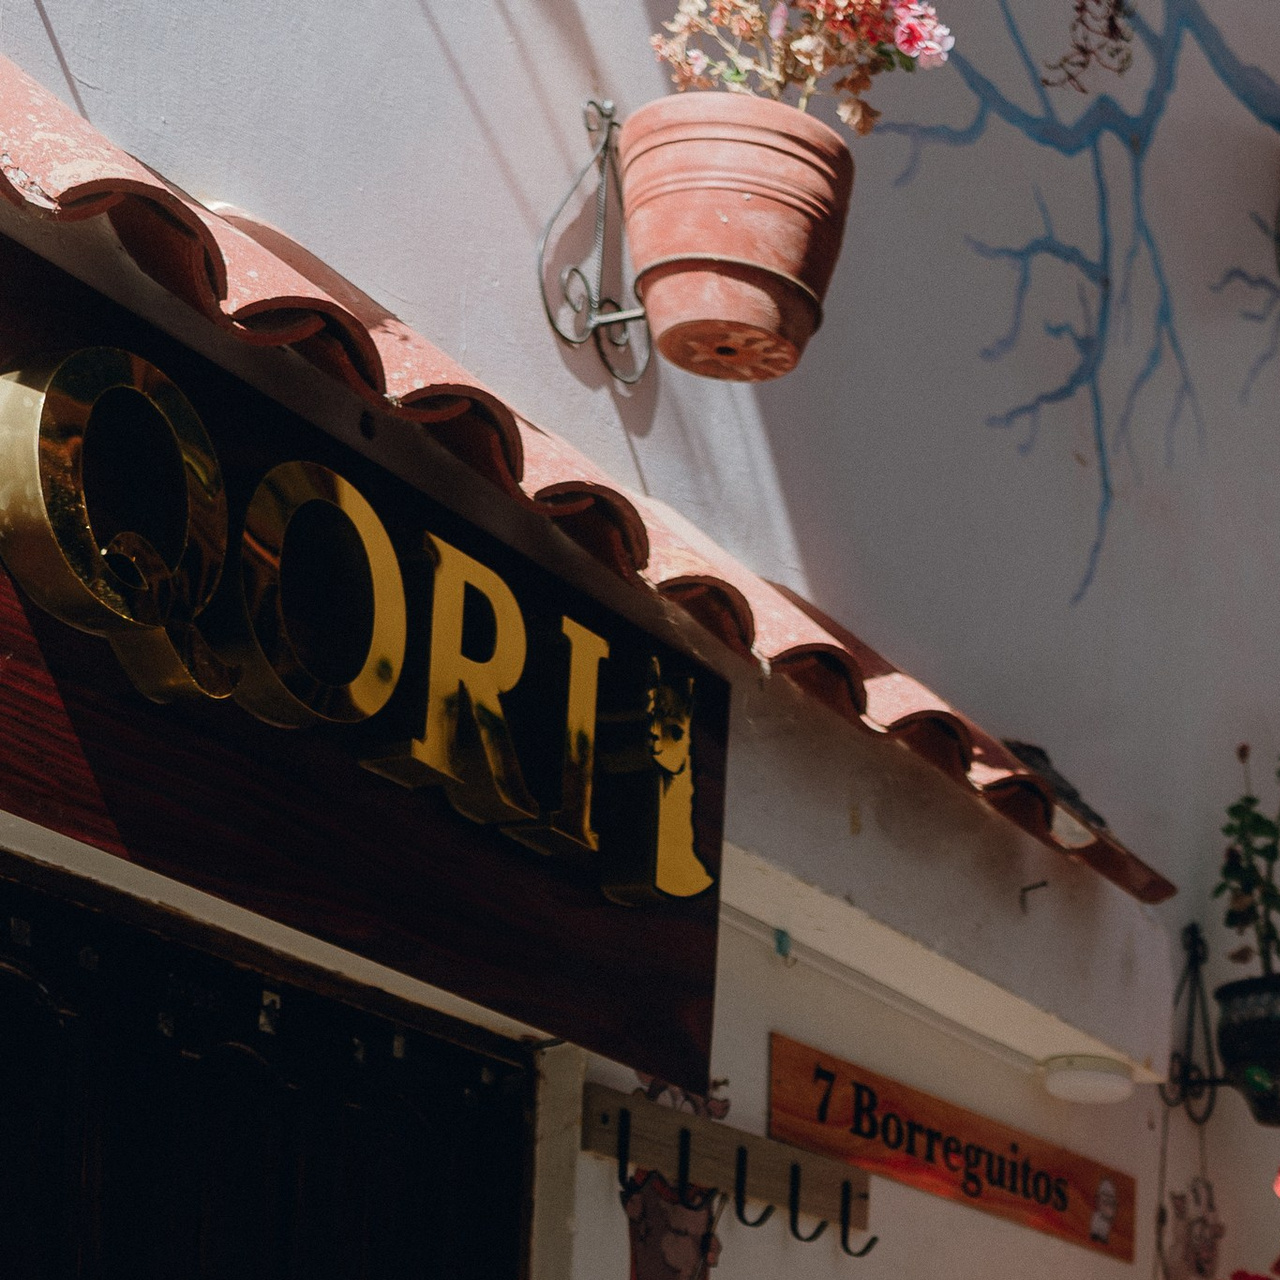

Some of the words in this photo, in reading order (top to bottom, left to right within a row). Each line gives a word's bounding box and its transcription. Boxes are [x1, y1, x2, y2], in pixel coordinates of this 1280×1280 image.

[30, 346, 611, 853] QORI
[813, 1063, 836, 1124] 7
[849, 1080, 1069, 1212] Borreguitos
